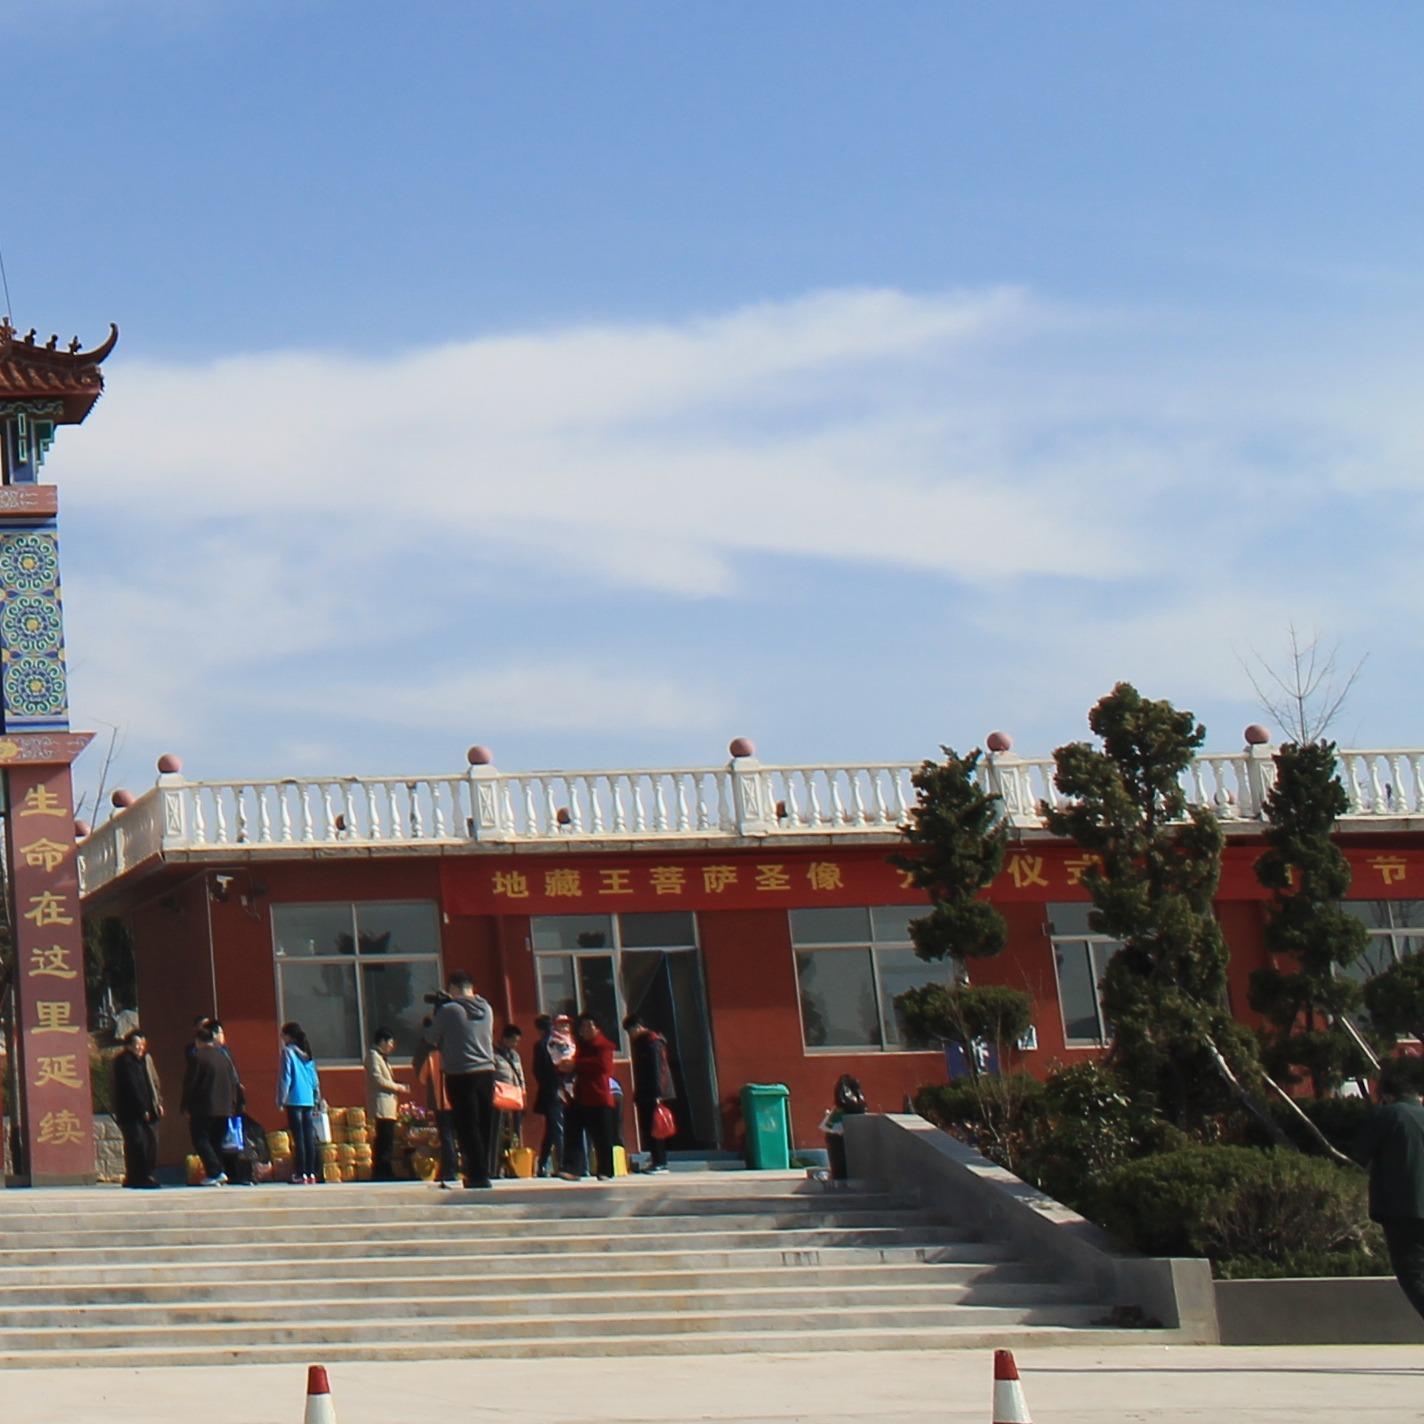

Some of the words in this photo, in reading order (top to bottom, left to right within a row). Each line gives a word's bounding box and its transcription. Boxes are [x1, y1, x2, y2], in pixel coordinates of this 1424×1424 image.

[18, 783, 86, 1145] 生命在这里延续
[491, 860, 845, 899] 地藏王菩萨圣像
